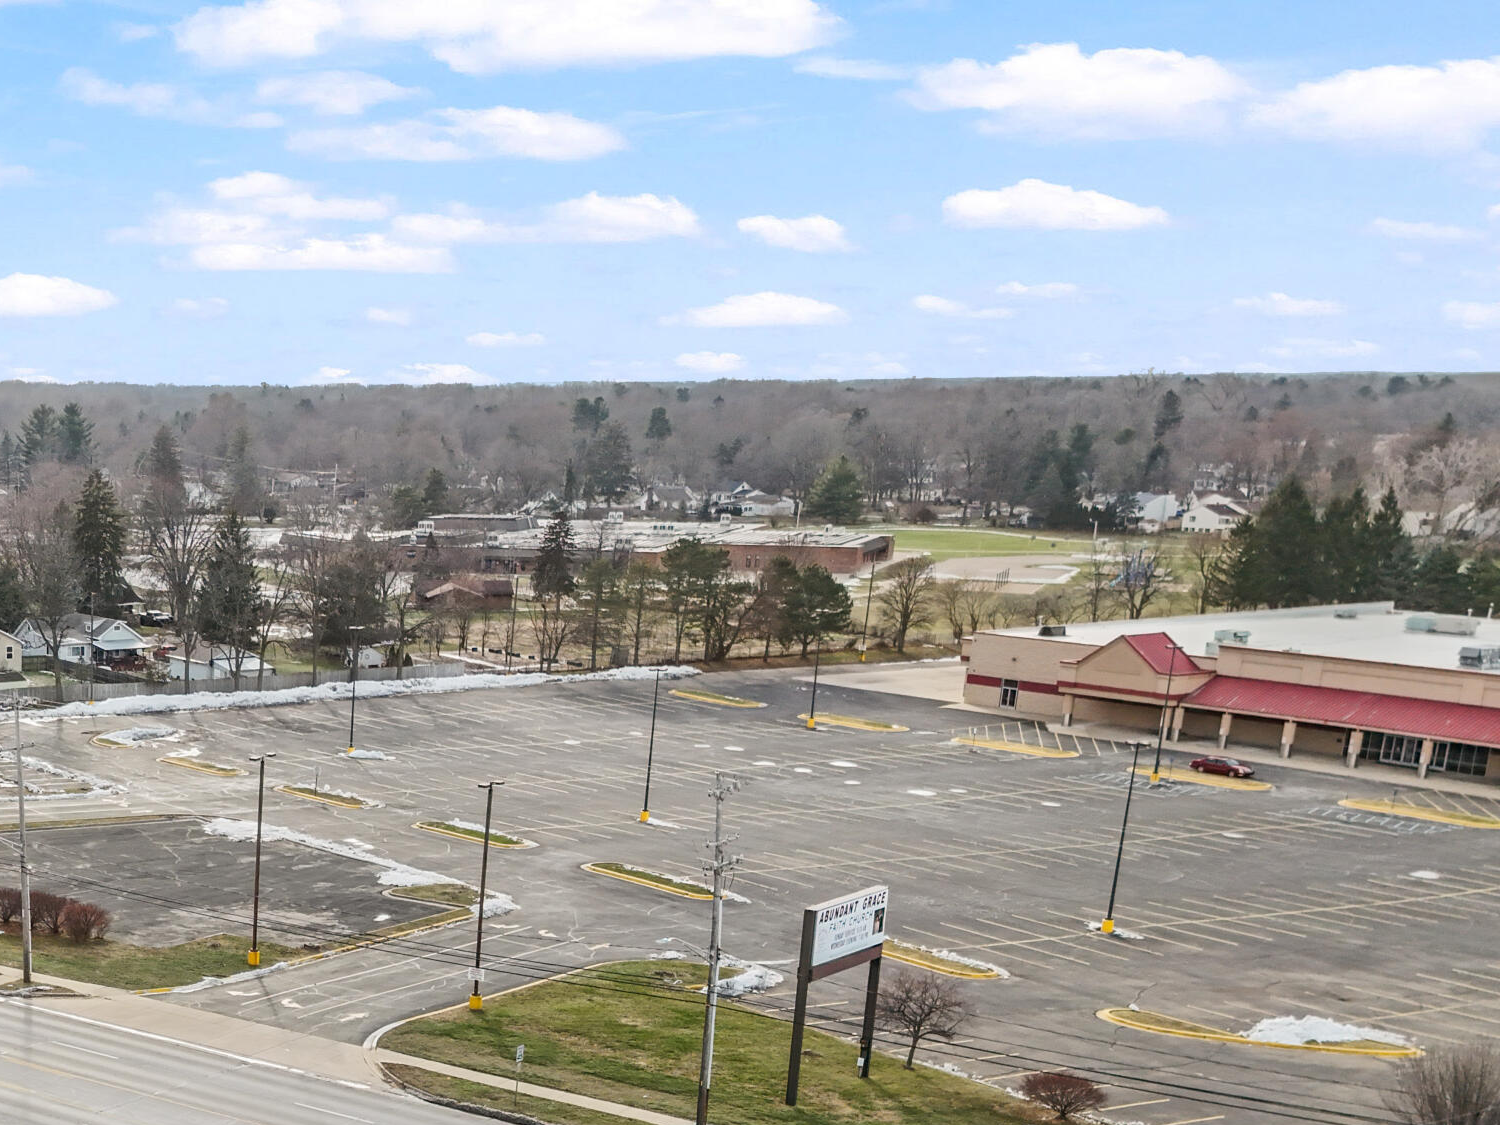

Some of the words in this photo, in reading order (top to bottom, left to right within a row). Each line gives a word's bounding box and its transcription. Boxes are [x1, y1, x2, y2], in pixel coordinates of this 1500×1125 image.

[819, 900, 859, 924] ABUNDANT
[863, 891, 886, 910] GRACE
[849, 910, 873, 926] CHURCH
